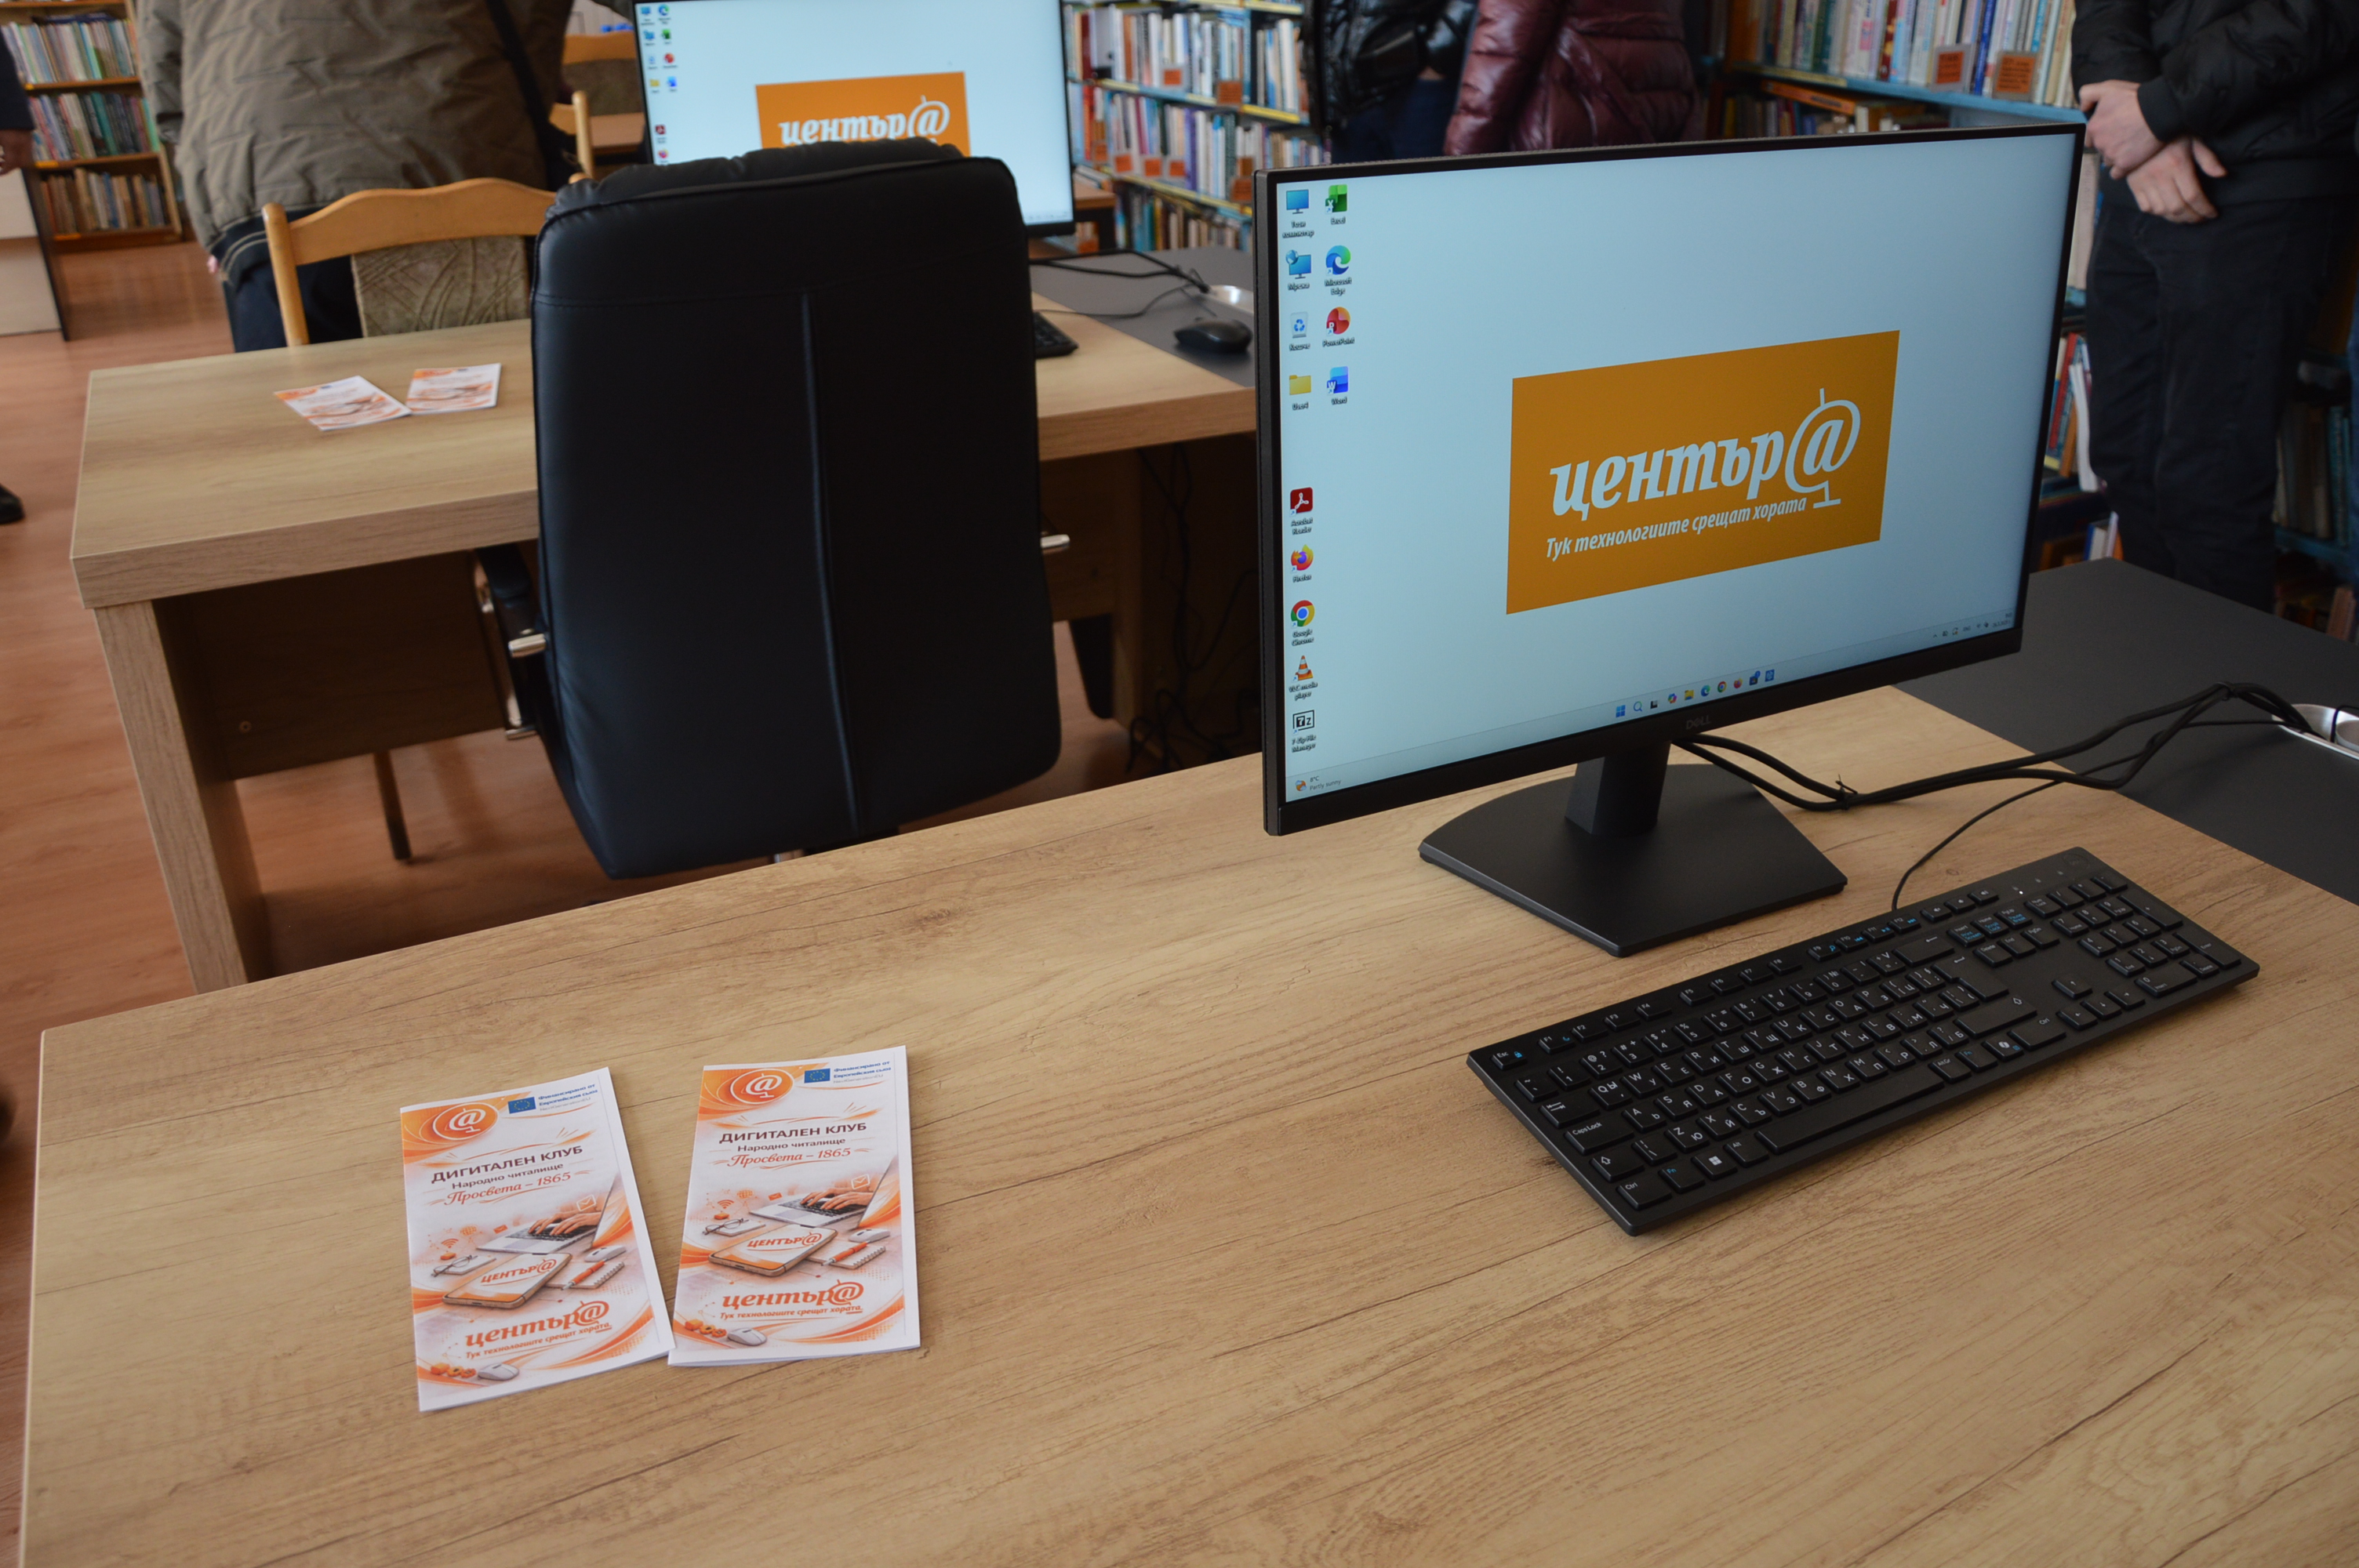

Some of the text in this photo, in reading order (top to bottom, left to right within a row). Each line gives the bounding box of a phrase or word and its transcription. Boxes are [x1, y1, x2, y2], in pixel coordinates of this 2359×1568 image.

[1549, 387, 1861, 521] център@
[1547, 497, 1807, 562] Тук технологиите срещат хората
[1738, 1045, 1750, 1054] Ш
[1710, 1055, 1720, 1064] И
[1854, 1058, 1866, 1066] M
[1772, 1066, 1783, 1075] Ж
[1826, 1069, 1837, 1077] N
[1629, 1072, 1642, 1081] W
[1607, 1081, 1619, 1090] Ы
[1663, 1095, 1673, 1104] S
[1705, 1115, 1717, 1123] X
[1725, 1119, 1736, 1128] Й
[1586, 1122, 1602, 1131] Lock
[719, 1123, 867, 1144] ДИГИТАЛЕН КЛУБ
[1673, 1127, 1685, 1136] Z
[1691, 1132, 1703, 1141] Ю
[737, 1138, 846, 1152] Народно читалище
[727, 1152, 803, 1168] Просвета
[817, 1148, 851, 1159] 1865
[431, 1145, 583, 1185] ДИГИТАЛЕН КЛУБ
[452, 1163, 564, 1190] Народно читалище
[444, 1182, 522, 1205] Просвета
[536, 1171, 572, 1186] 1865
[722, 1279, 864, 1310] център@
[737, 1310, 795, 1319] технологиите
[797, 1308, 828, 1316] срещат
[465, 1300, 609, 1348] център@
[466, 1351, 481, 1359] Тук
[484, 1338, 543, 1356] технологиите
[545, 1330, 577, 1344] срещат
